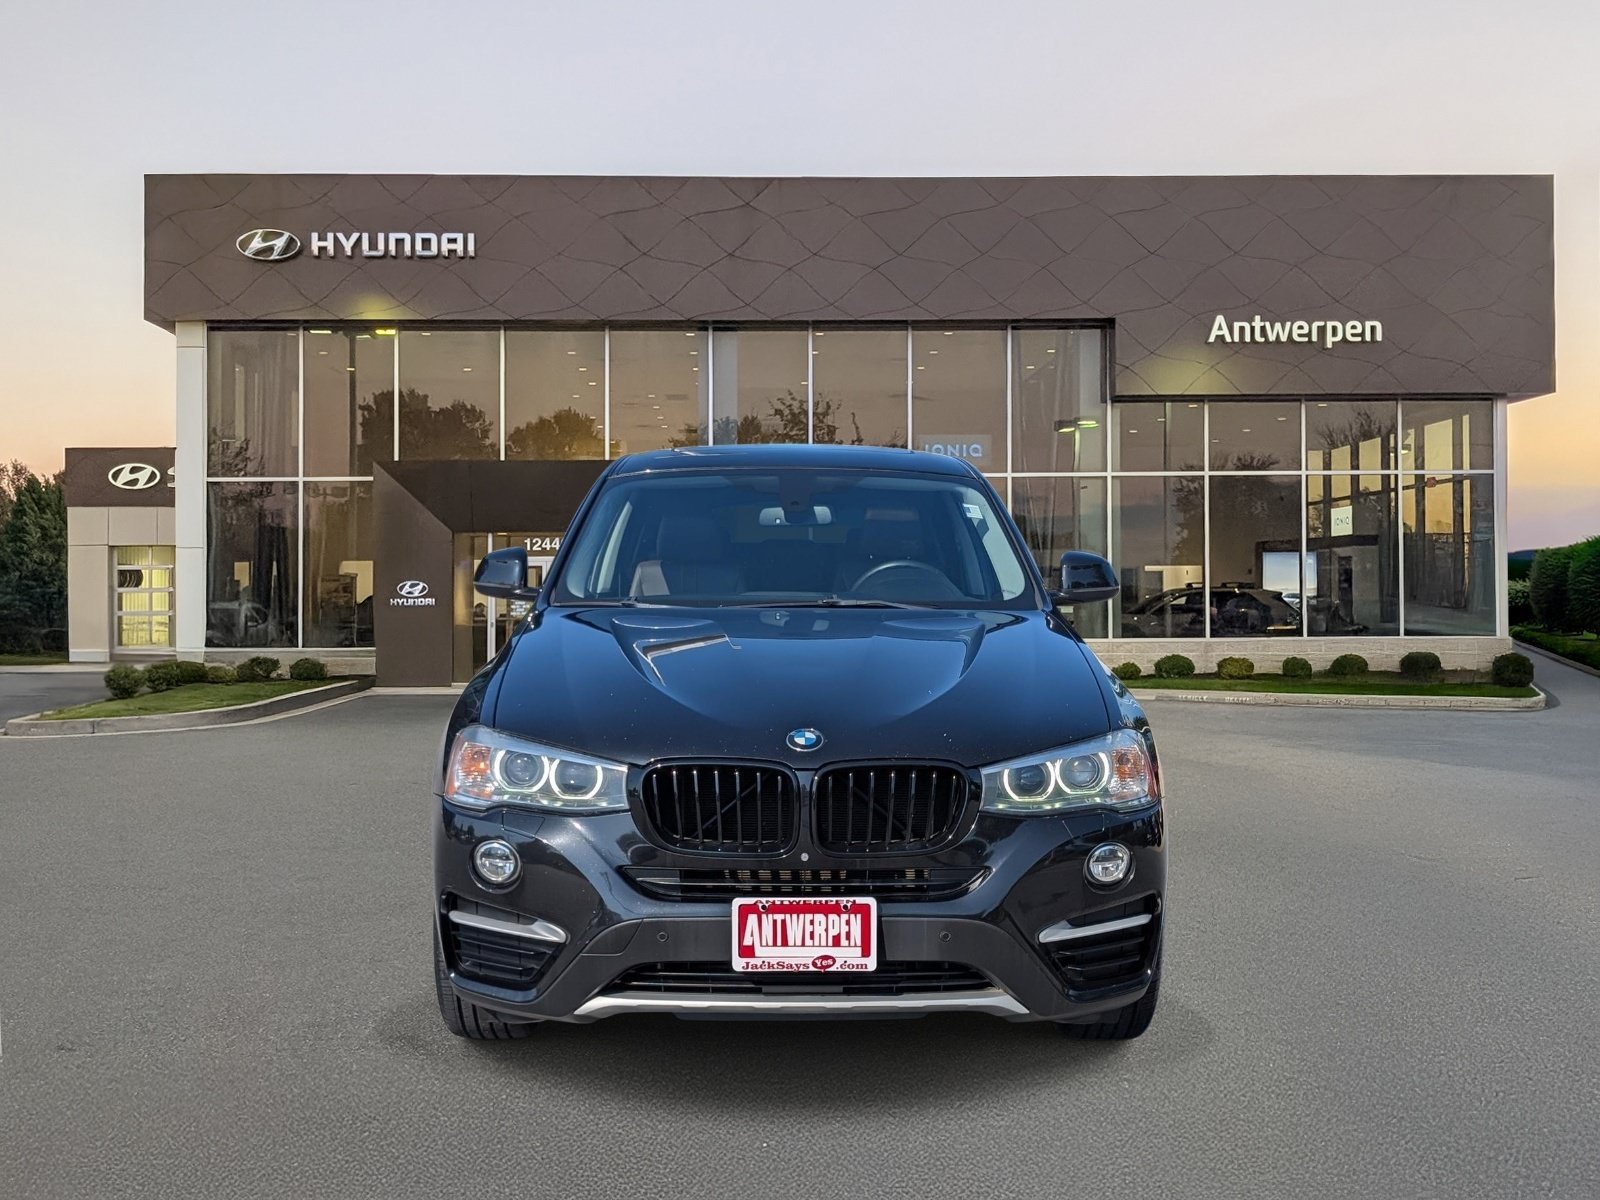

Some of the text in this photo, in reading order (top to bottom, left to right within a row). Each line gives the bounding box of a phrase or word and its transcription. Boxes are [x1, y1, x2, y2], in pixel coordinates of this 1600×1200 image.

[310, 232, 476, 258] HYUNDAI
[1207, 314, 1383, 349] Antwerpen
[523, 537, 563, 551] 1244
[389, 598, 436, 606] HYUNDAI
[743, 913, 862, 948] ANTWERPEN
[814, 958, 834, 967] Yes
